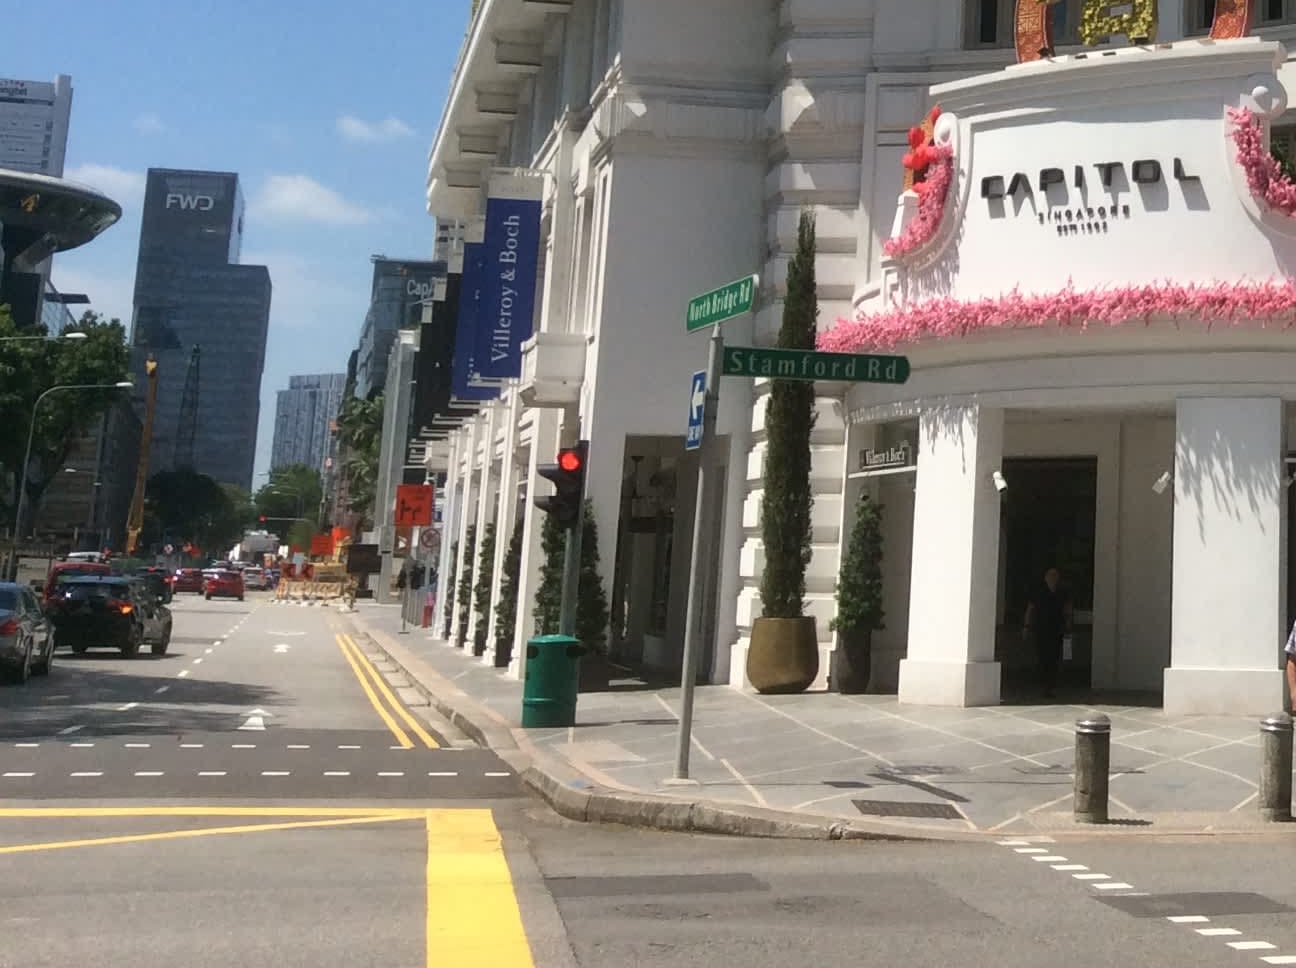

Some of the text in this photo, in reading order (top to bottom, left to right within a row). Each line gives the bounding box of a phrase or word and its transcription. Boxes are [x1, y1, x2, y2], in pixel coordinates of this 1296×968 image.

[981, 157, 1201, 199] CAPITOL
[166, 193, 215, 211] FWD
[491, 214, 521, 363] Villeroy & Boch
[689, 279, 751, 321] North Bridge Rd
[729, 350, 897, 380] Stamford Rd
